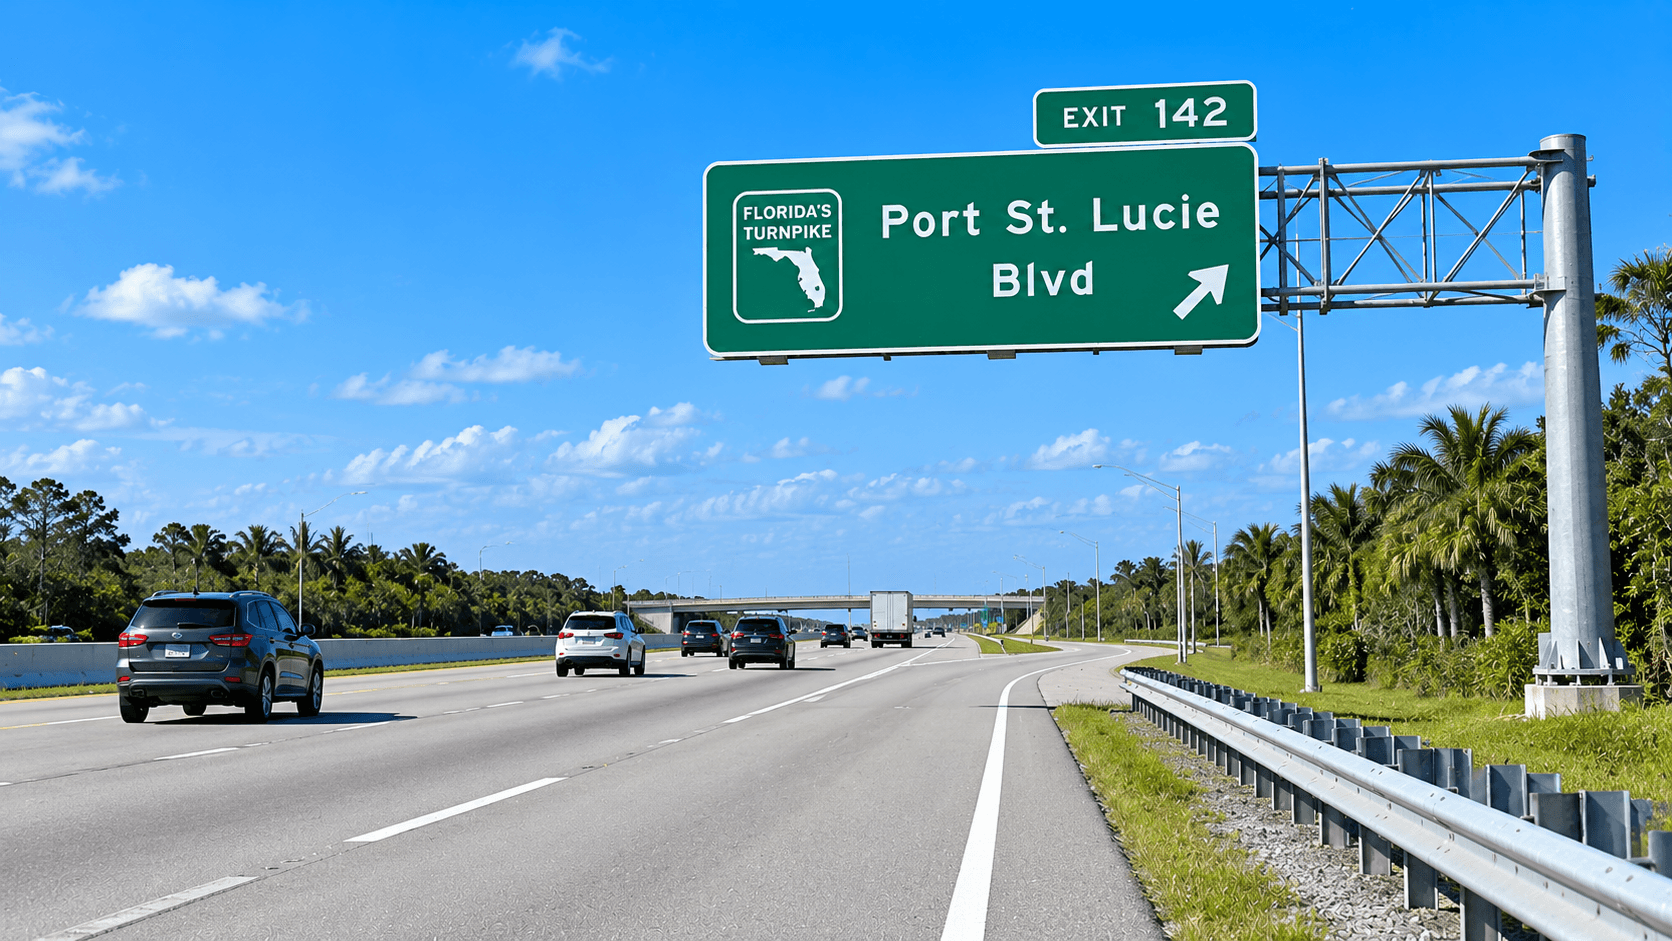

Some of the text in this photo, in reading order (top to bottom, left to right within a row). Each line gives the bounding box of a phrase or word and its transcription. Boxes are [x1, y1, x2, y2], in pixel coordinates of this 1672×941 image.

[1063, 96, 1228, 129] EXIT 142
[743, 203, 832, 221] FLORIDA'S
[881, 193, 1220, 239] Port St. Lucie
[743, 223, 832, 241] TURNPIKE
[992, 260, 1094, 298] Blvd
